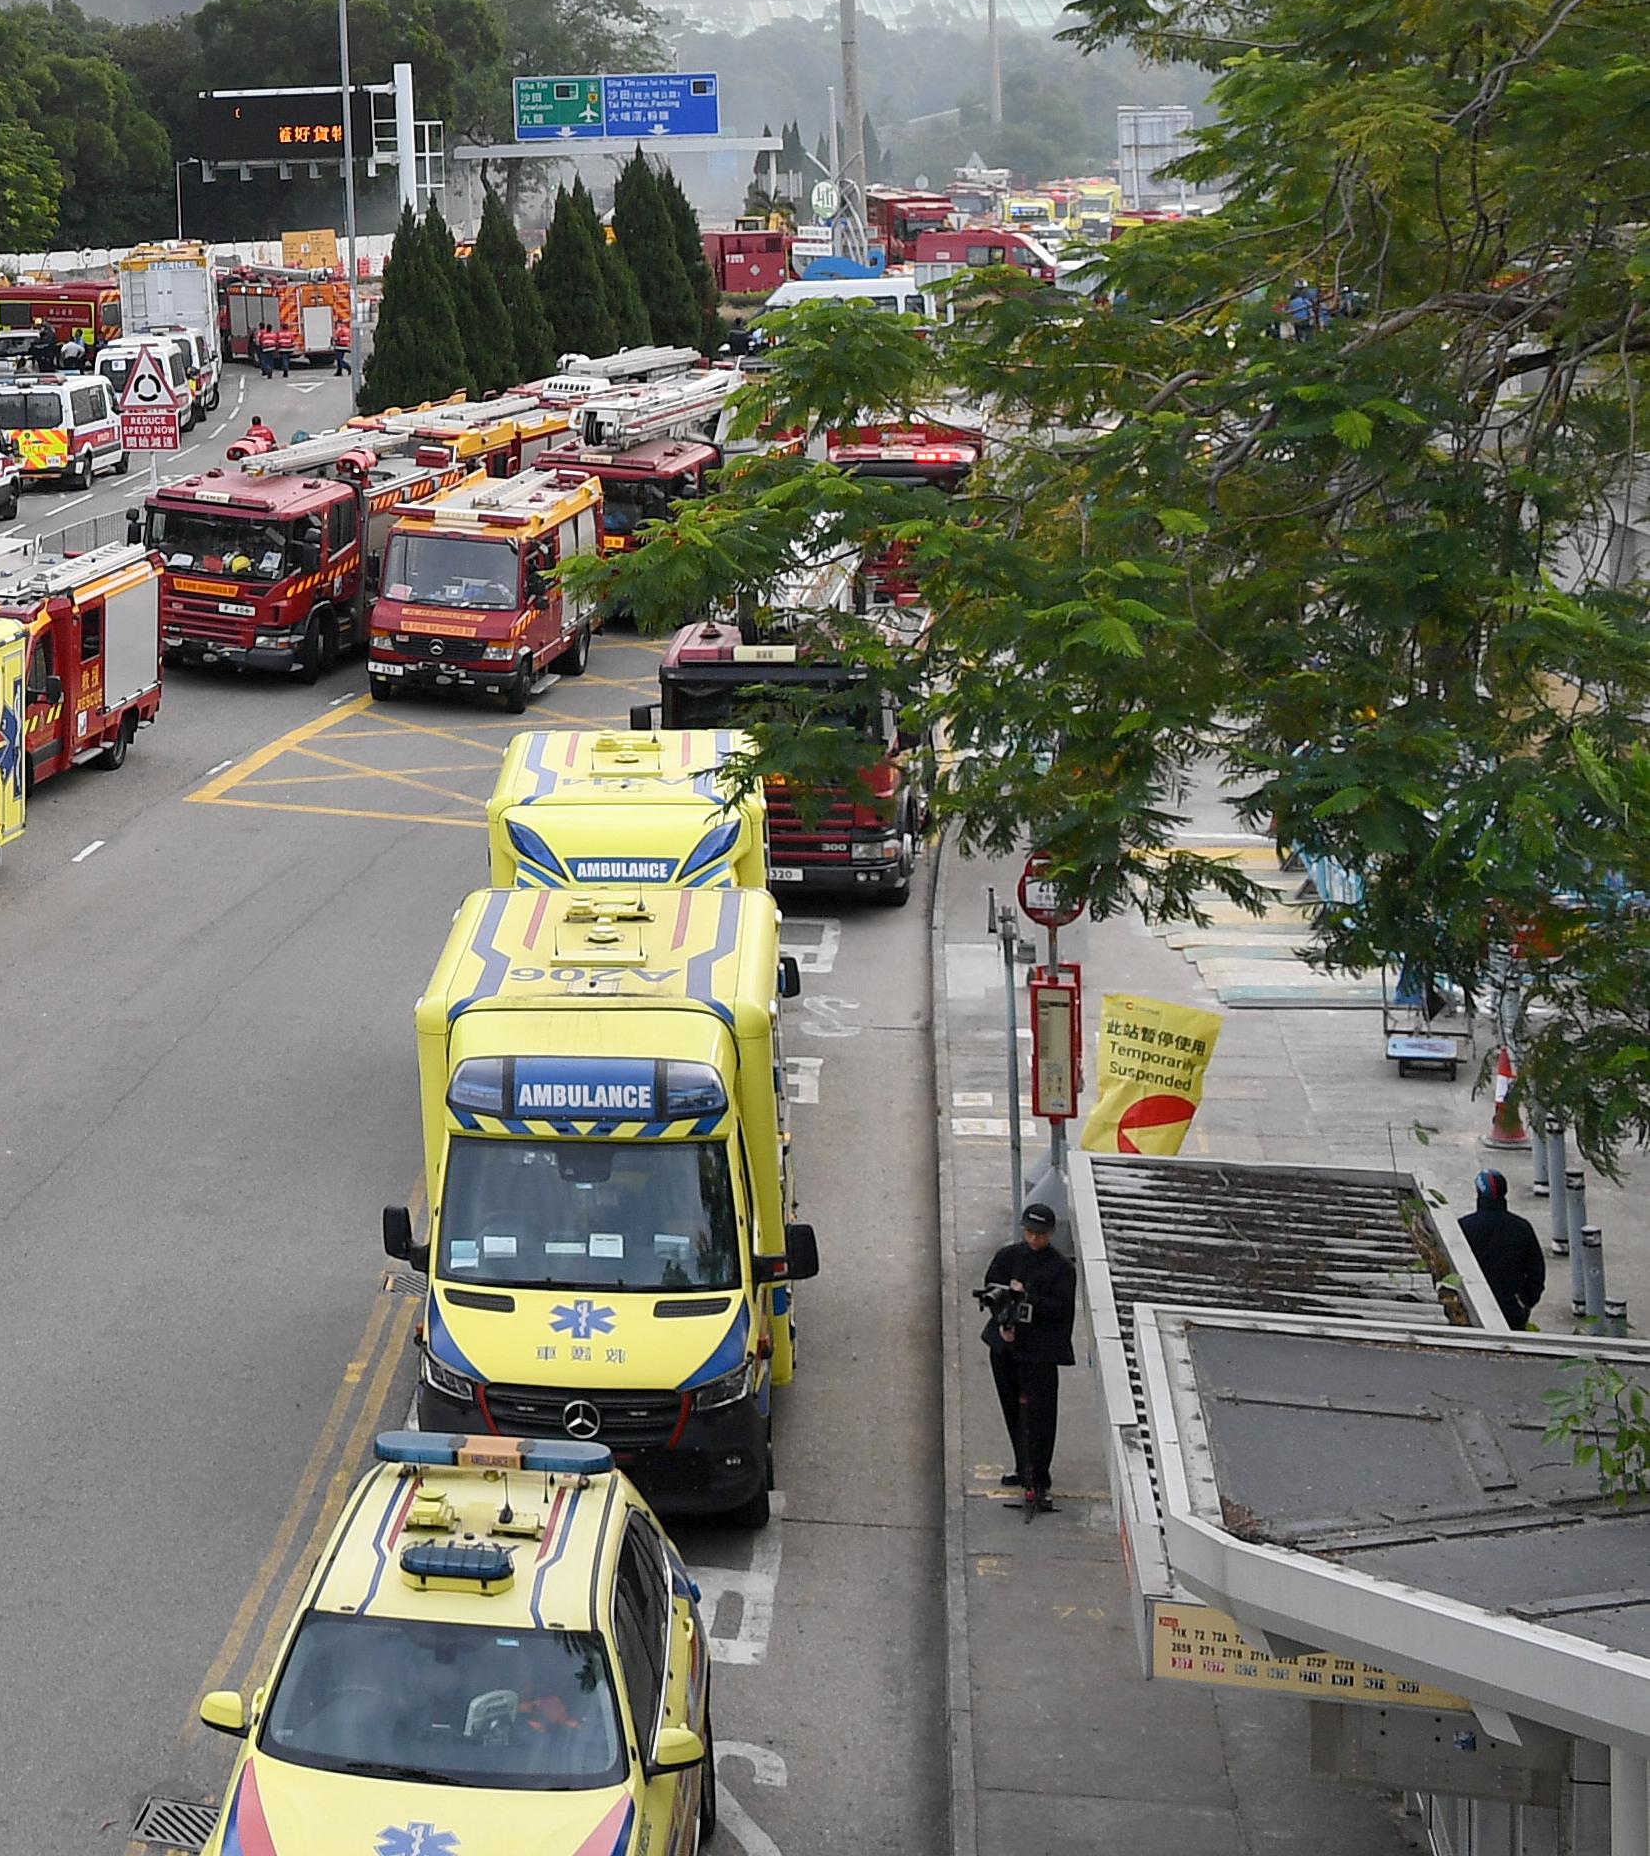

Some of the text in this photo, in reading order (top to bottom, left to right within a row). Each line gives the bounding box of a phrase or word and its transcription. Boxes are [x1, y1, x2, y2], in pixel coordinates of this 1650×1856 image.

[130, 416, 166, 425] REDUCE
[123, 426, 175, 435] SPEED NOW
[821, 843, 848, 851] 300
[576, 862, 669, 879] AMBULANCE
[509, 966, 681, 983] A206
[1106, 1019, 1207, 1056] 此站暫停使用
[1109, 1041, 1196, 1076] Temporarily
[1109, 1061, 1193, 1092] Suspended
[518, 1084, 652, 1110] AMBULANCE
[1195, 1629, 1205, 1641] 72
[1212, 1631, 1228, 1642] 72A
[1200, 1645, 1215, 1656] 271
